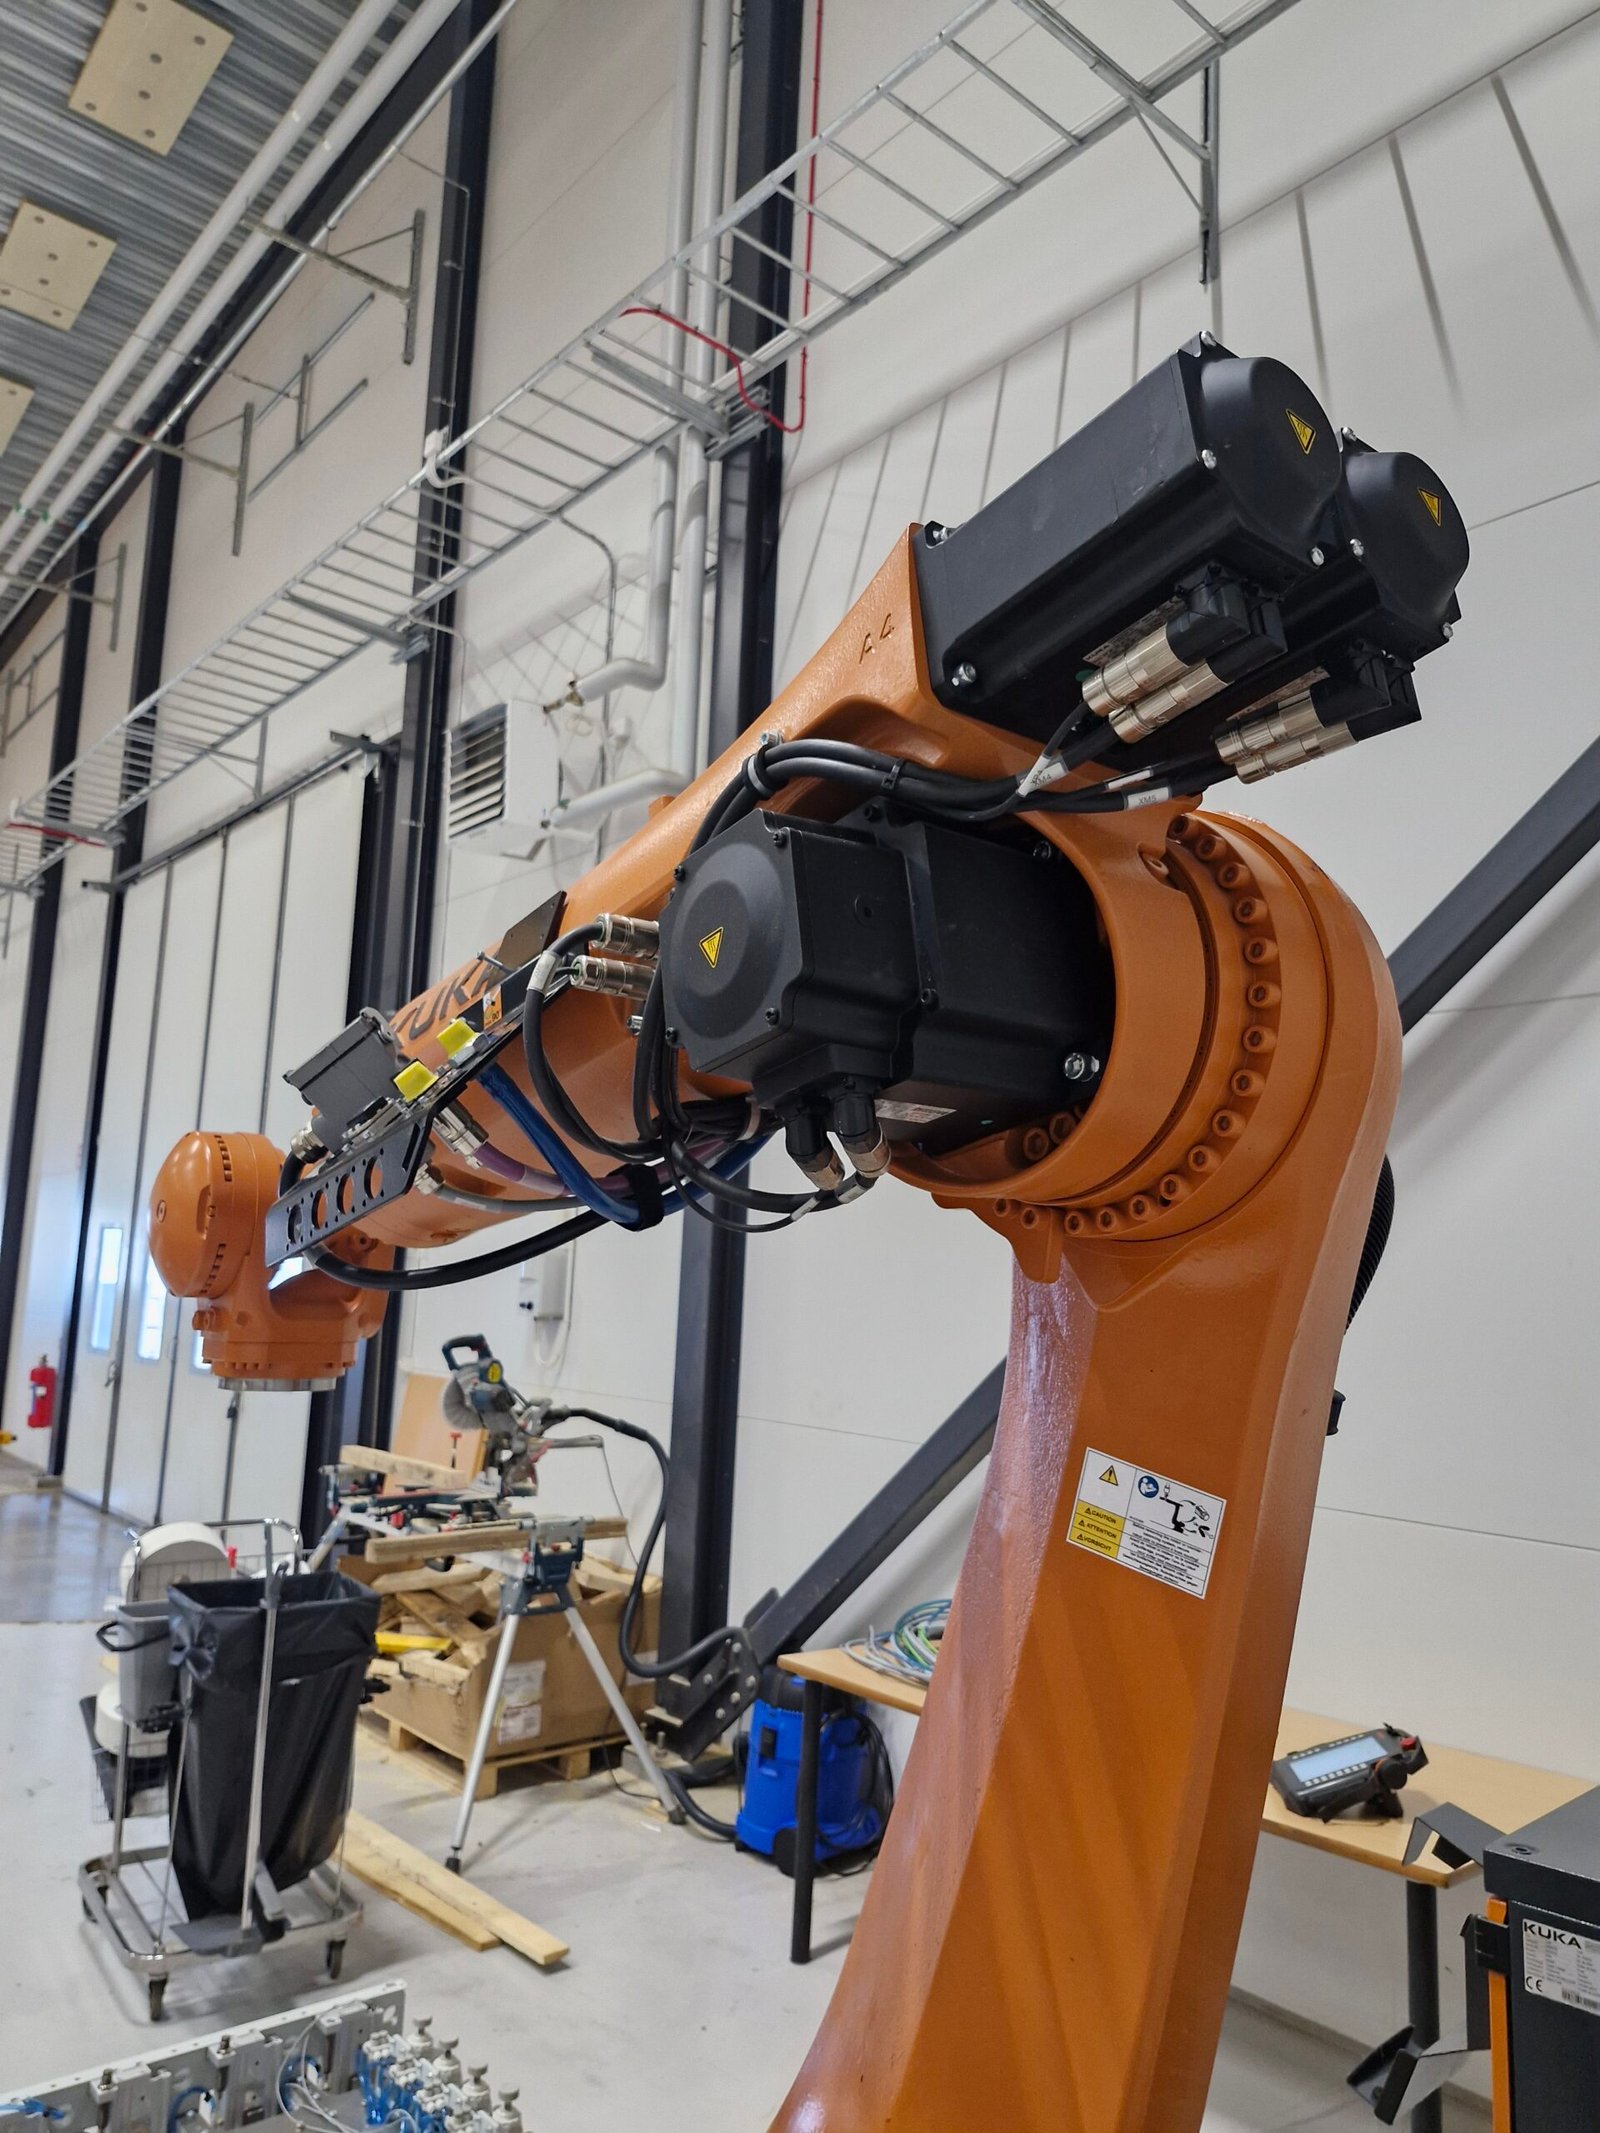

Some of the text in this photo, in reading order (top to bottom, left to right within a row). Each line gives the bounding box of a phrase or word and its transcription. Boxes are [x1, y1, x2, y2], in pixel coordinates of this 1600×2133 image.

[1091, 1510, 1117, 1524] CAUTION
[1086, 1522, 1117, 1539] ATTENTION
[1083, 1536, 1112, 1551] VORSICHT
[1523, 1921, 1582, 1950] KUKA
